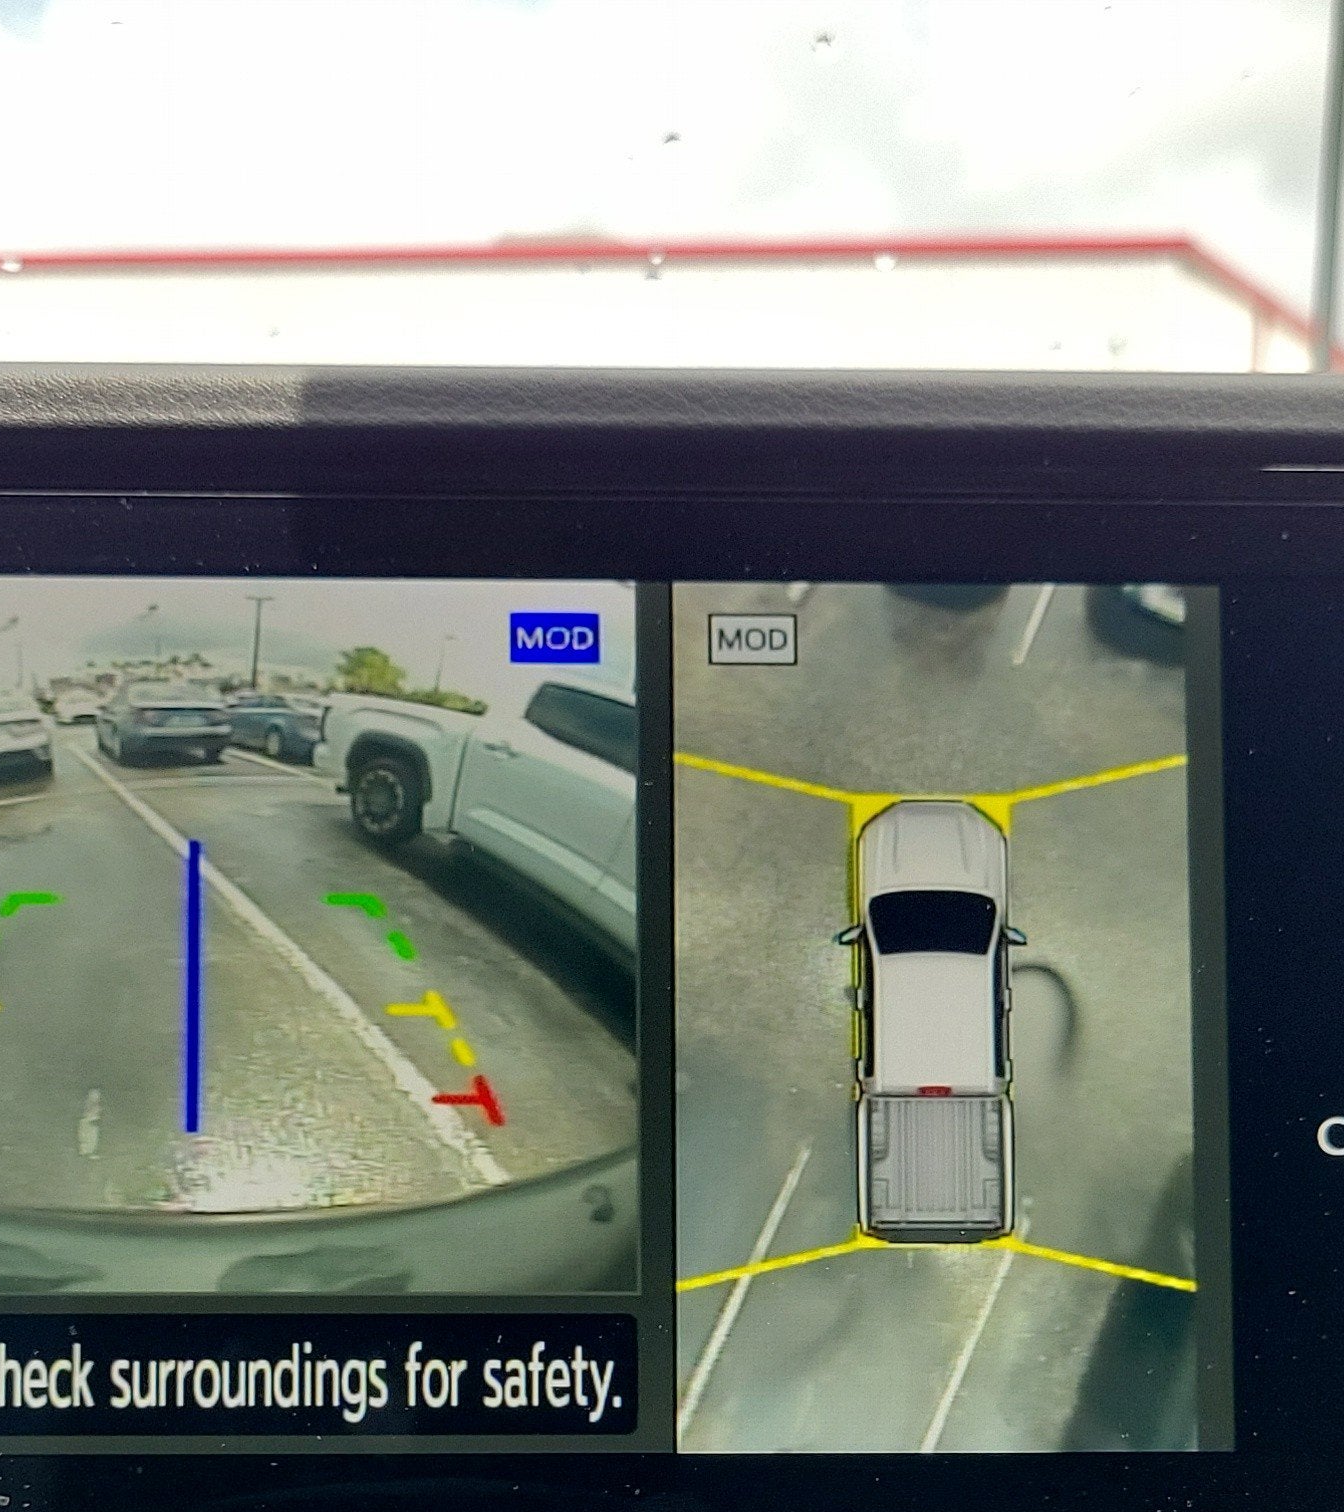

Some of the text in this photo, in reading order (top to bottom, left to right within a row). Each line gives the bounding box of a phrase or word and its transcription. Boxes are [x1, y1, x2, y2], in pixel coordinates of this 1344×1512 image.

[516, 626, 594, 650] MOD
[718, 628, 788, 651] MOD
[110, 1341, 388, 1422] surroundings
[405, 1341, 468, 1408] for
[482, 1341, 623, 1423] safety.
